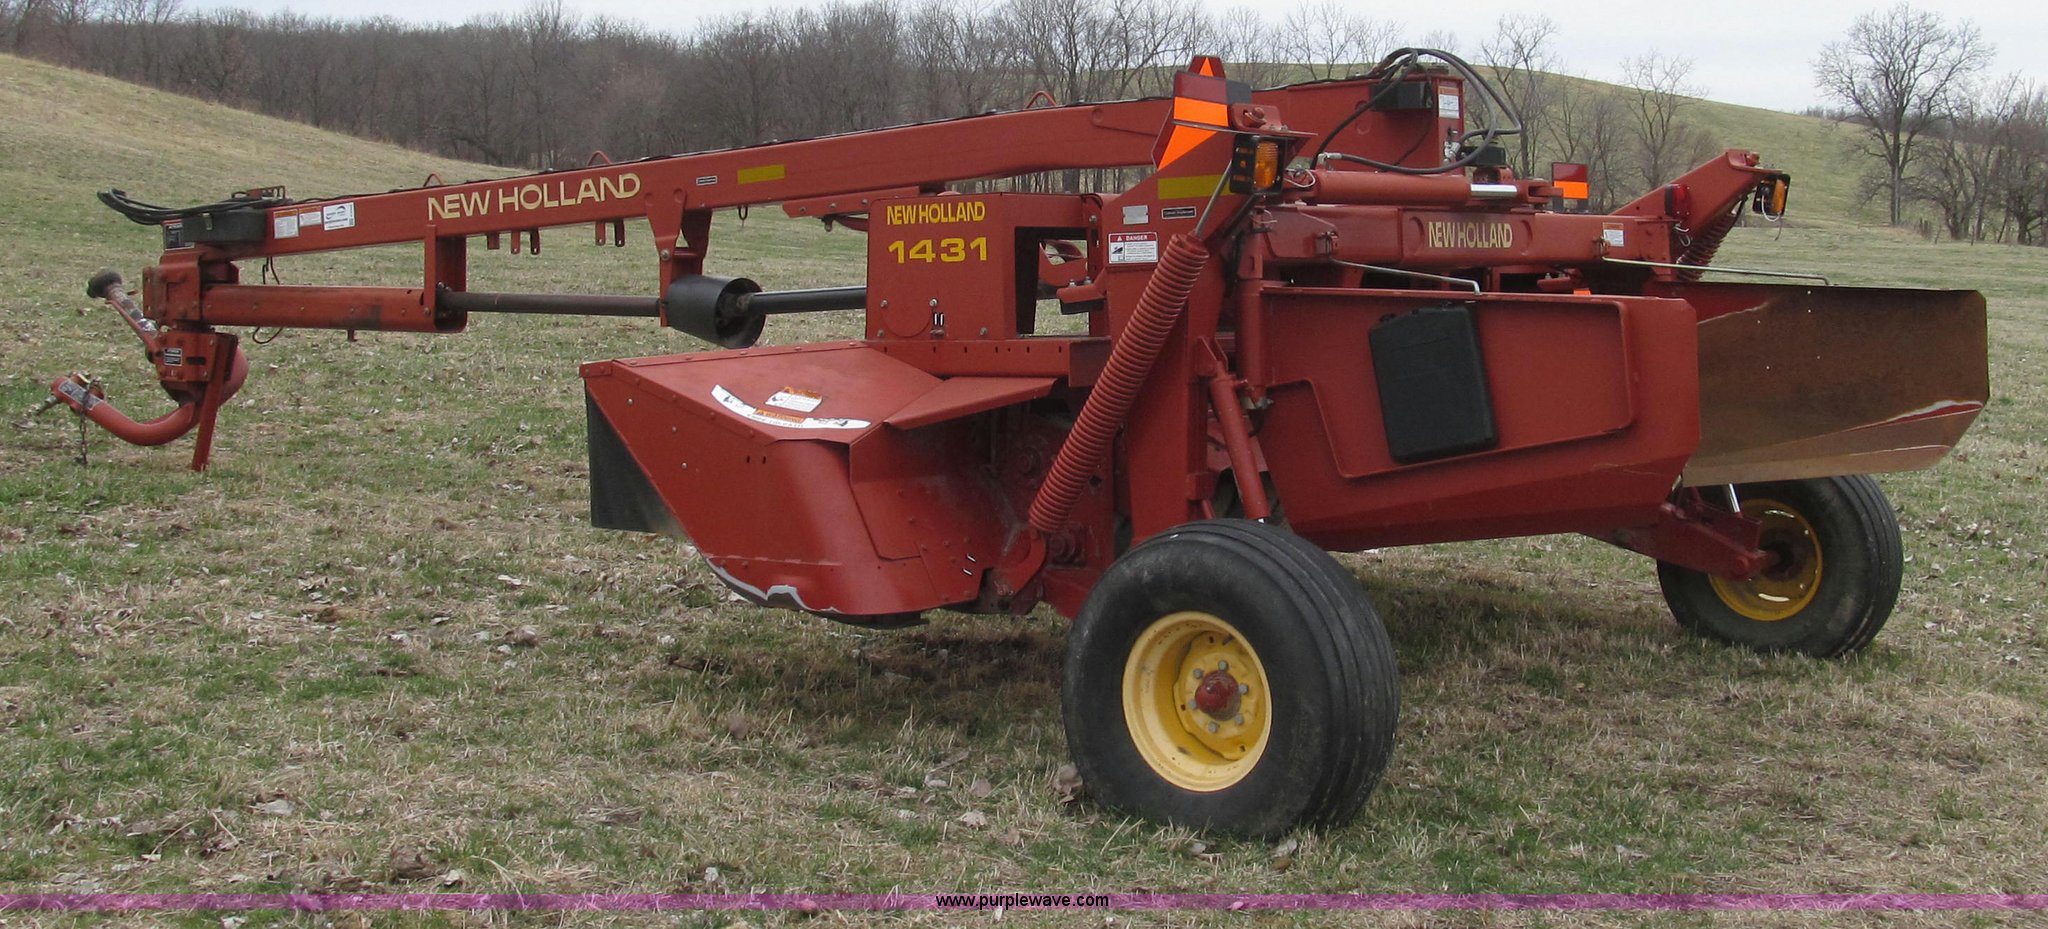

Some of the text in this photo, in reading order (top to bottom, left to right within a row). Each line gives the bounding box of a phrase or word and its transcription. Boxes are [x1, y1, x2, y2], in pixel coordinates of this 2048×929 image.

[427, 173, 641, 221] NEW HOLLAND
[886, 201, 986, 225] NEW HOLLAND
[1428, 221, 1513, 248] NEW HOLLAND
[888, 236, 987, 264] 1431
